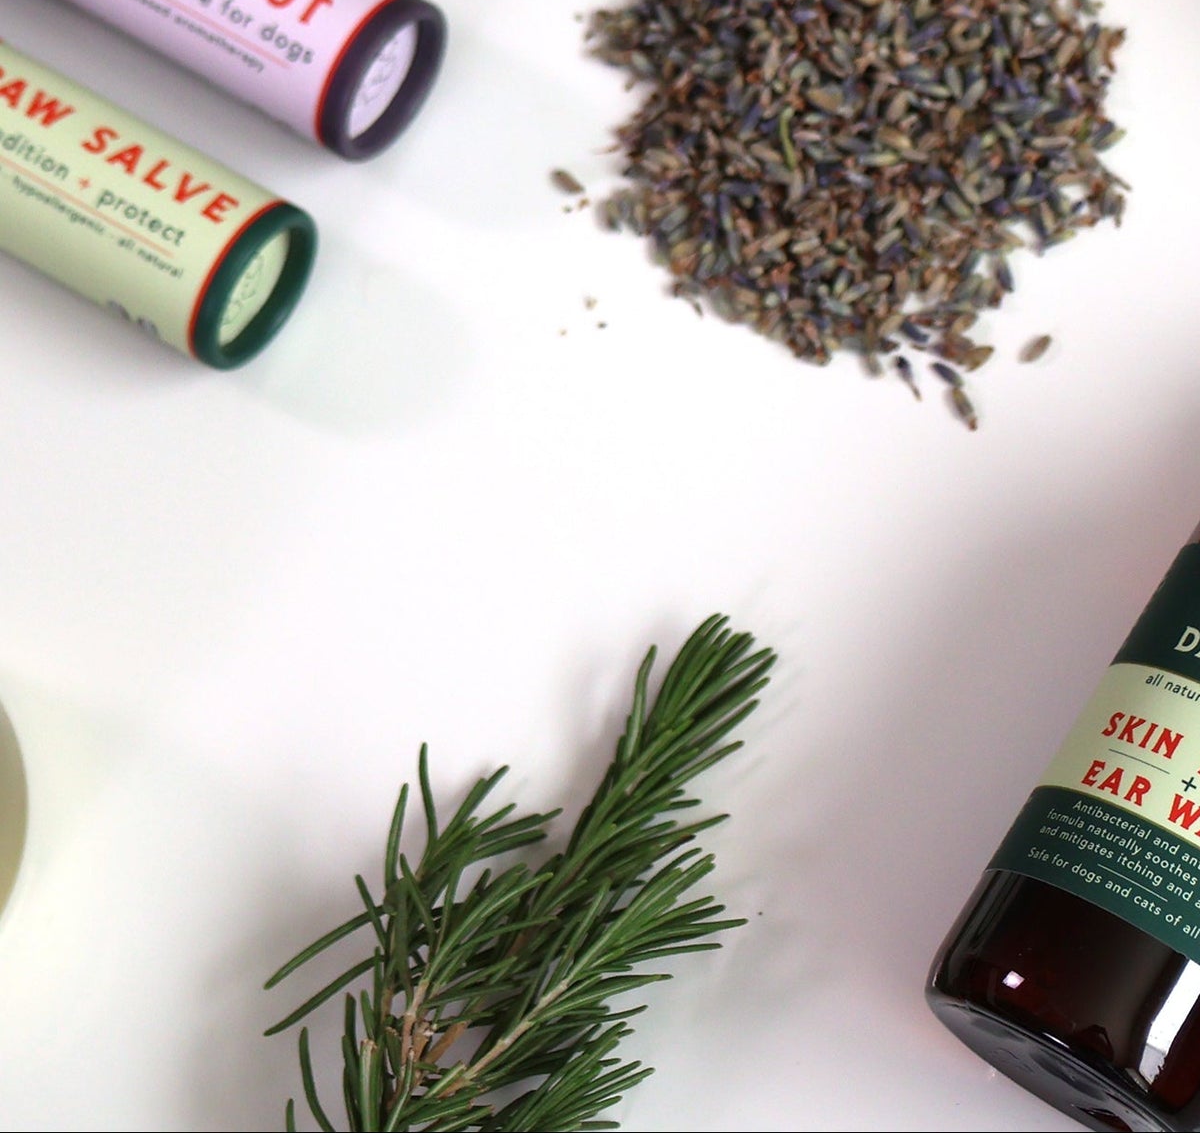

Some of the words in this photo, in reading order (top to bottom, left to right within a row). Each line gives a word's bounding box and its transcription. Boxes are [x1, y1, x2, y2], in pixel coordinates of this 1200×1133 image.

[260, 24, 316, 66] dogs
[0, 65, 75, 128] AW
[81, 126, 239, 226] SALVE
[97, 188, 186, 246] protect
[1145, 673, 1163, 686] all
[1102, 711, 1184, 760] SKIN
[1081, 759, 1151, 807] EAR
[1046, 808, 1085, 829] formula
[1087, 824, 1143, 855] naturally
[1144, 851, 1199, 886] soothes
[1072, 799, 1152, 840] Antibacterial
[1153, 836, 1180, 856] and
[1039, 824, 1058, 837] and
[1059, 830, 1114, 859] mitigates
[1117, 853, 1163, 887] itching
[1166, 881, 1193, 902] and
[1027, 847, 1049, 862] Safe
[1051, 853, 1070, 869] for
[1072, 861, 1103, 884] dogs
[1104, 879, 1132, 899] and
[1133, 894, 1162, 916] cats
[1165, 913, 1184, 927] of
[1182, 922, 1200, 940] all
